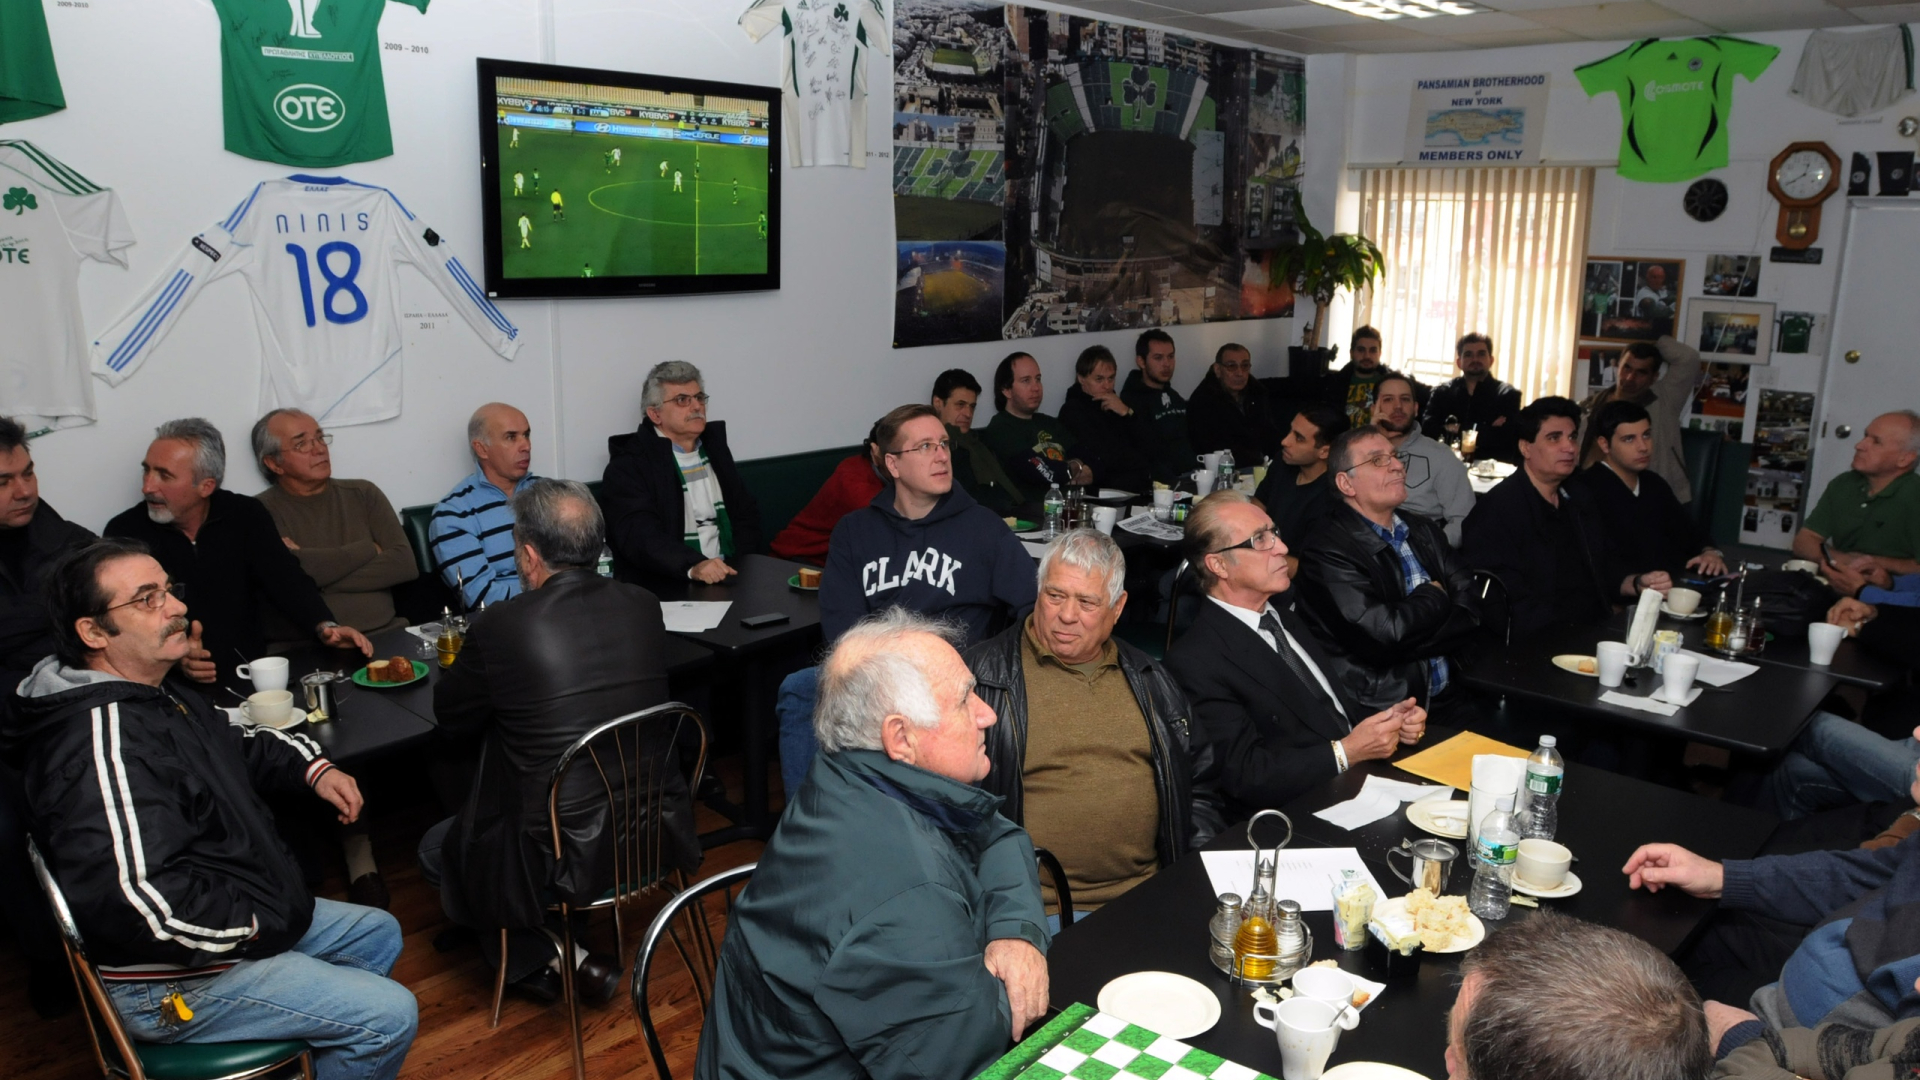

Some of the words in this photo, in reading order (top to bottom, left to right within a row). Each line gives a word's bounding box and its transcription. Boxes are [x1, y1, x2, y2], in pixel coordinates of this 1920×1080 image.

[384, 42, 402, 51] 2009
[411, 45, 429, 54] 2010
[1417, 78, 1470, 90] PANSAMIAN
[1472, 75, 1545, 88] BROTHERHOOD
[280, 96, 337, 121] OTE
[1451, 98, 1473, 107] NEW
[1476, 96, 1503, 106] YORK
[1418, 150, 1483, 161] MEMBERS
[1487, 149, 1523, 160] ONLY
[0, 247, 30, 264] TE
[285, 241, 369, 328] 18
[862, 546, 962, 597] CLARK
